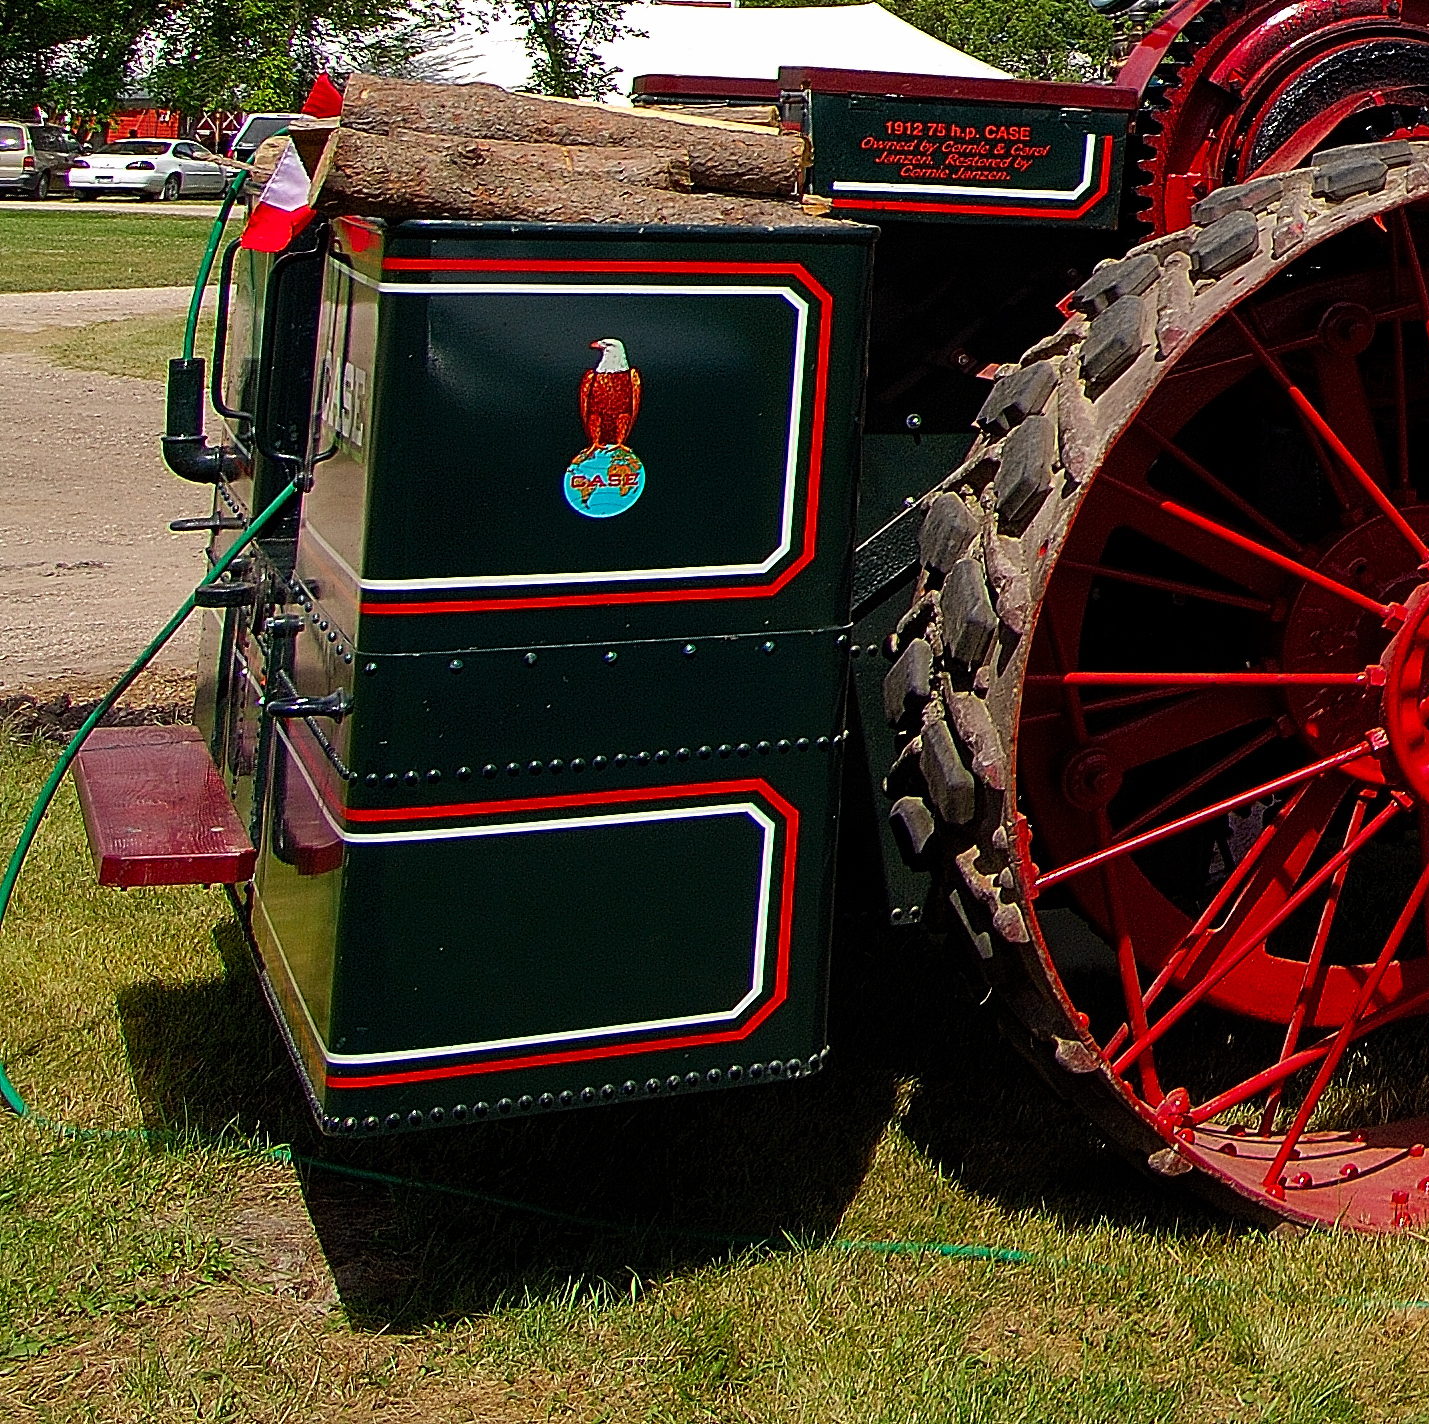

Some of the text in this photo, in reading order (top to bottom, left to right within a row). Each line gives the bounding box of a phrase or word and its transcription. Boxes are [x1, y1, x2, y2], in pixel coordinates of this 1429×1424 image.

[885, 121, 1031, 141] 1912 75 h.p. CASE
[861, 137, 1052, 156] Owned by Cornie & Carol
[875, 151, 1034, 172] Janzen. Restored by
[900, 164, 1012, 180] Cornie Janzen.
[570, 473, 640, 489] CASE
